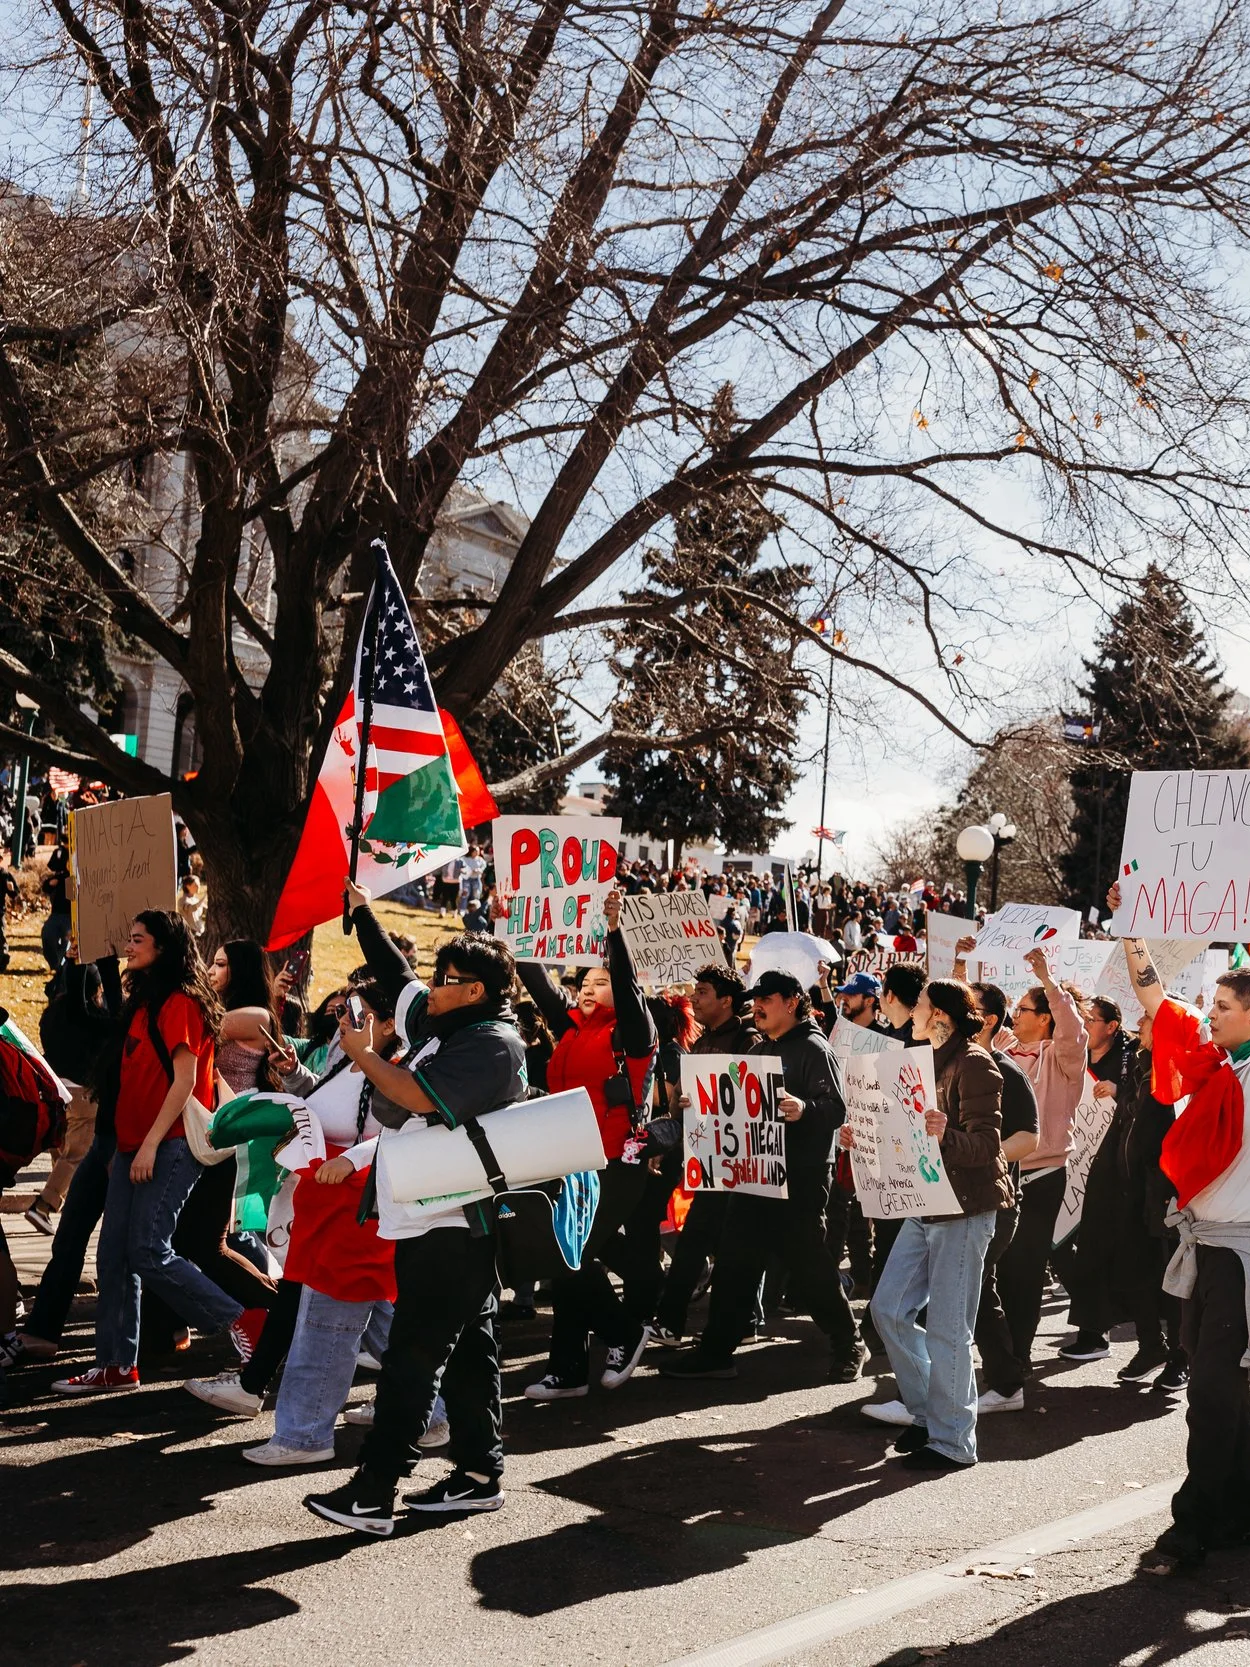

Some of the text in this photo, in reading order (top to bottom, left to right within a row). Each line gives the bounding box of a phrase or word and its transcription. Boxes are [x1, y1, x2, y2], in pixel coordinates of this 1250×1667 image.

[82, 800, 155, 857] MAGA
[511, 828, 618, 891] PROUD
[1170, 840, 1214, 877] TU
[563, 894, 591, 929] OF
[619, 893, 709, 926] MIS PADRES
[1000, 907, 1049, 926] VIVA
[627, 919, 716, 943] TIENEN MAS
[696, 943, 716, 959] TU
[654, 961, 694, 984] PAIS
[696, 1072, 786, 1123] NO ONE
[687, 1155, 715, 1189] ON
[896, 1163, 917, 1175] TRUMP
[879, 1190, 926, 1216] GREAT!!!
